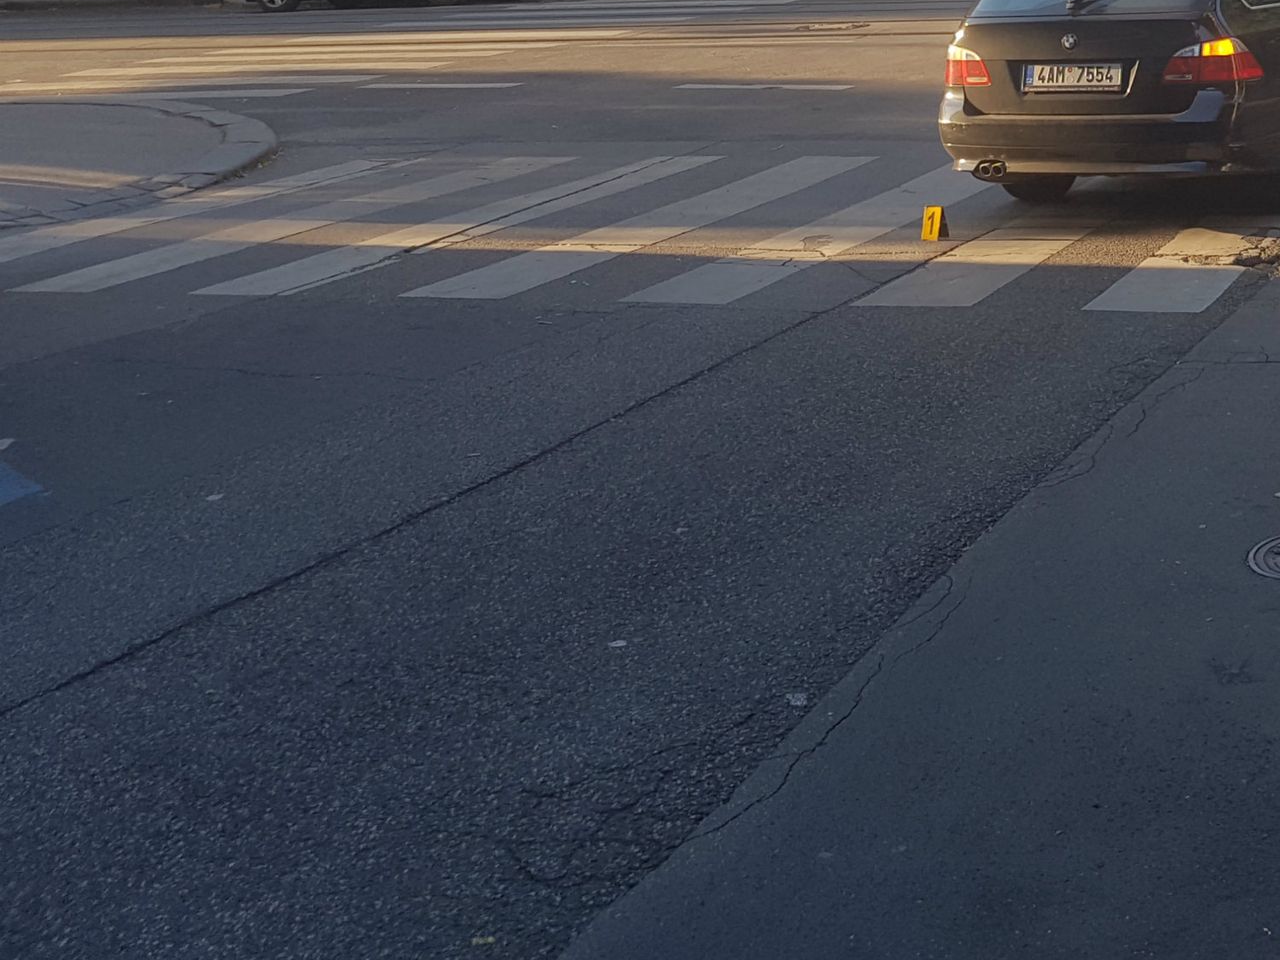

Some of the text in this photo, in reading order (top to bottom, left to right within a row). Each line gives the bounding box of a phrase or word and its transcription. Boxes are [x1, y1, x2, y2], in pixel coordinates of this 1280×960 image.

[1037, 66, 1114, 84] 4AM 7554
[927, 211, 936, 235] 1
